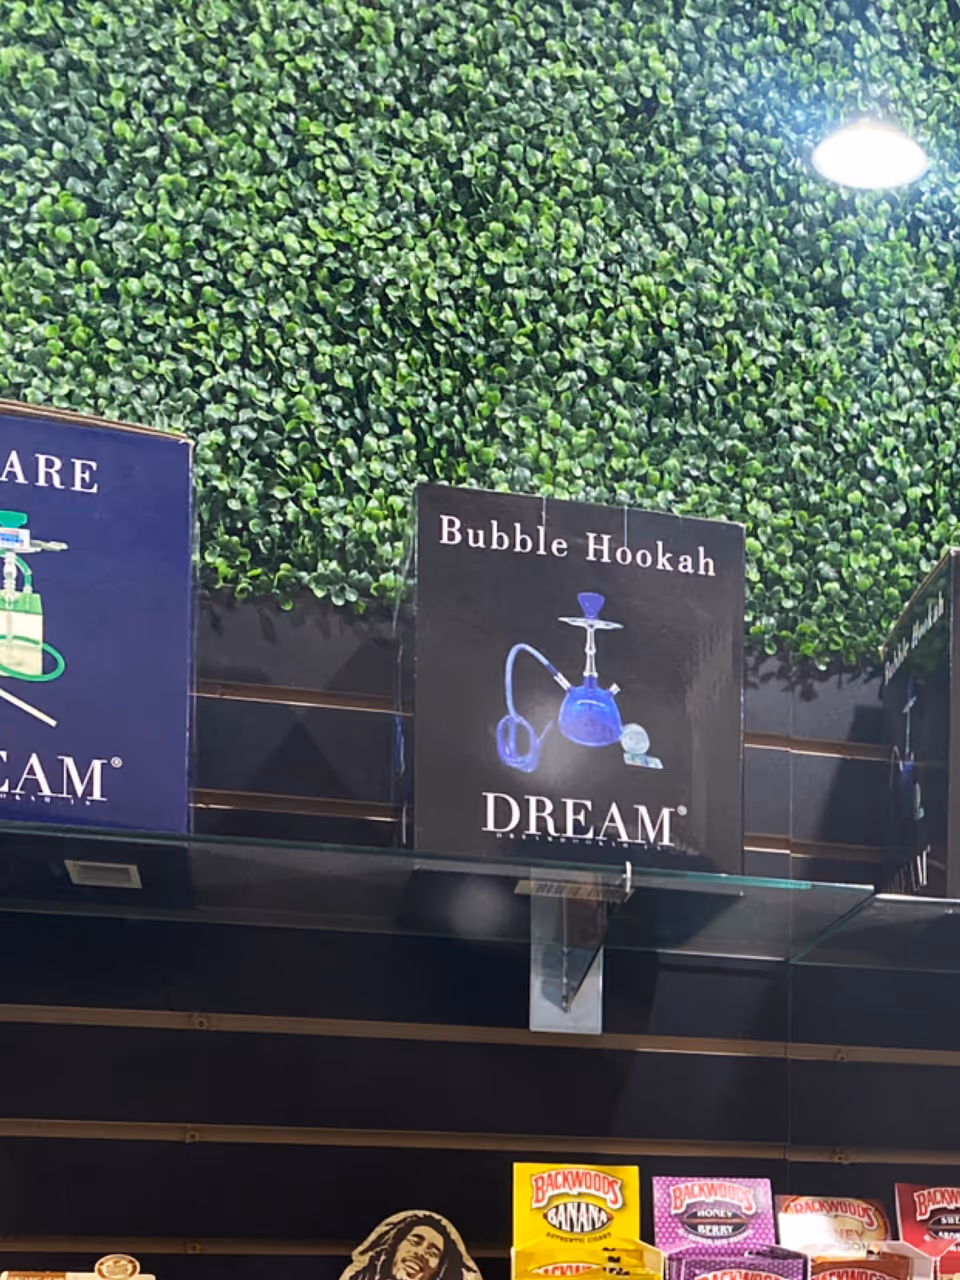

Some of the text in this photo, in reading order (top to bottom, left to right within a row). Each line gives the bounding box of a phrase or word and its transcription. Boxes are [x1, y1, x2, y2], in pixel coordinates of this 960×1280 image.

[439, 515, 716, 576] Bubble Hookah
[532, 1169, 623, 1210] BACKWOODS
[670, 1181, 757, 1215] BACKWOODS
[547, 1202, 608, 1233] BANANA
